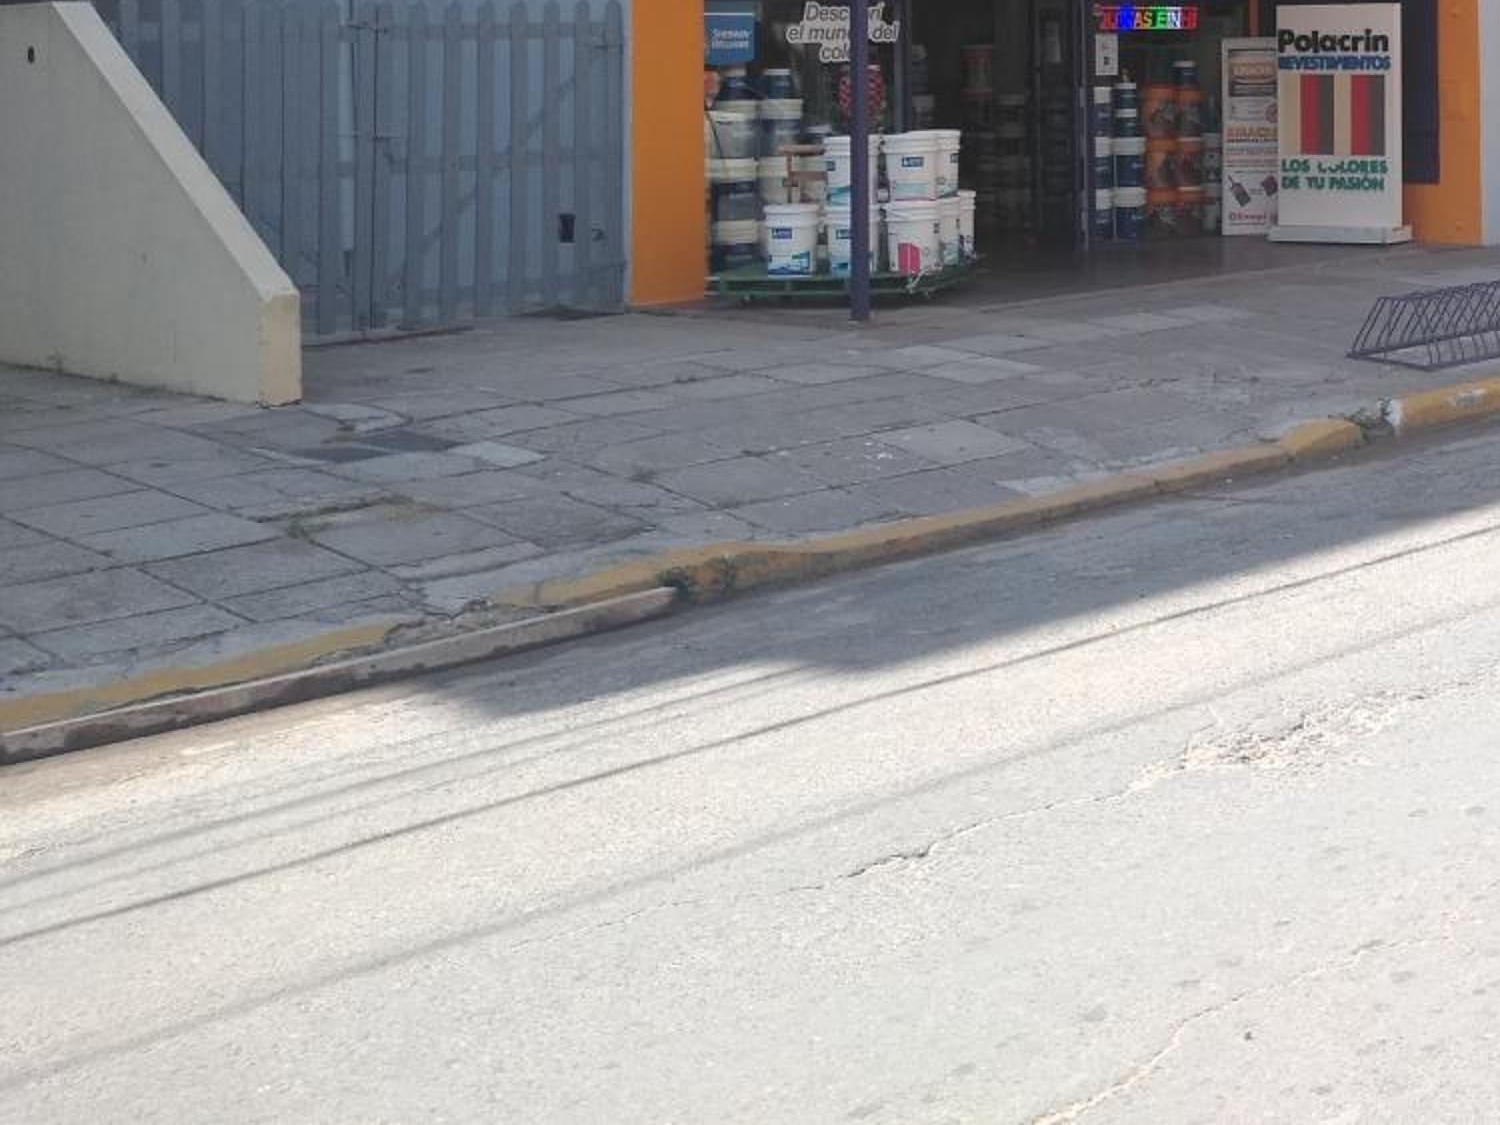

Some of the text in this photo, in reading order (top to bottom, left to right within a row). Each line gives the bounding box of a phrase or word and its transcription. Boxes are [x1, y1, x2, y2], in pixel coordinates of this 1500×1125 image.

[805, 2, 885, 22] Descrí
[788, 22, 806, 41] el
[871, 21, 899, 41] del
[1278, 28, 1390, 54] Polacrin
[1281, 158, 1311, 173] LOS
[1281, 176, 1302, 190] DE
[1305, 176, 1326, 191] TU
